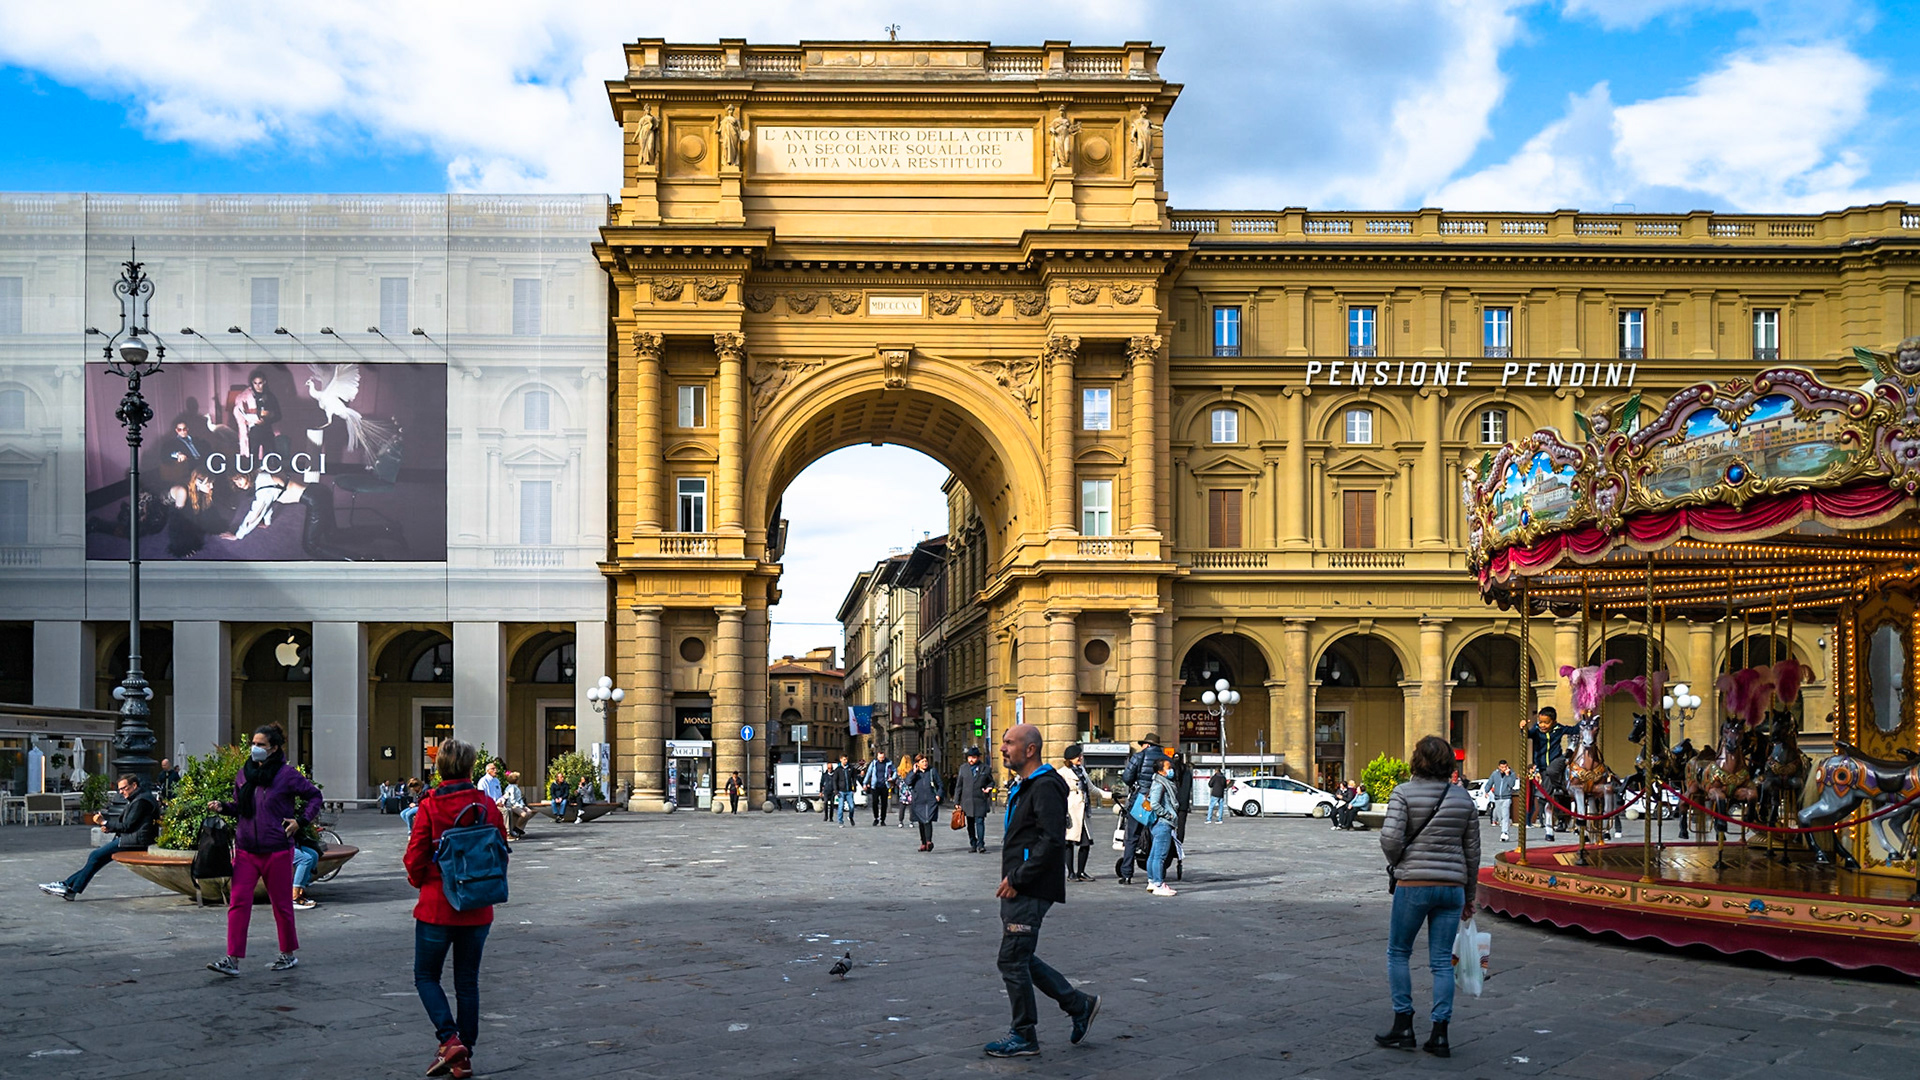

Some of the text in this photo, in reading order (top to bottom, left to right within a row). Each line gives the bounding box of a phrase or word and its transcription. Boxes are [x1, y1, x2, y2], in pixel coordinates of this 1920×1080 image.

[845, 130, 911, 141] CENTRO
[916, 130, 970, 141] DELLA
[787, 143, 1002, 156] DA SECOLARE SQUALLORE
[787, 157, 1002, 169] A VITA NUOVA RESTITUITO
[1304, 360, 1638, 388] PENSIONE PENDINI
[206, 452, 327, 475] GUCCI
